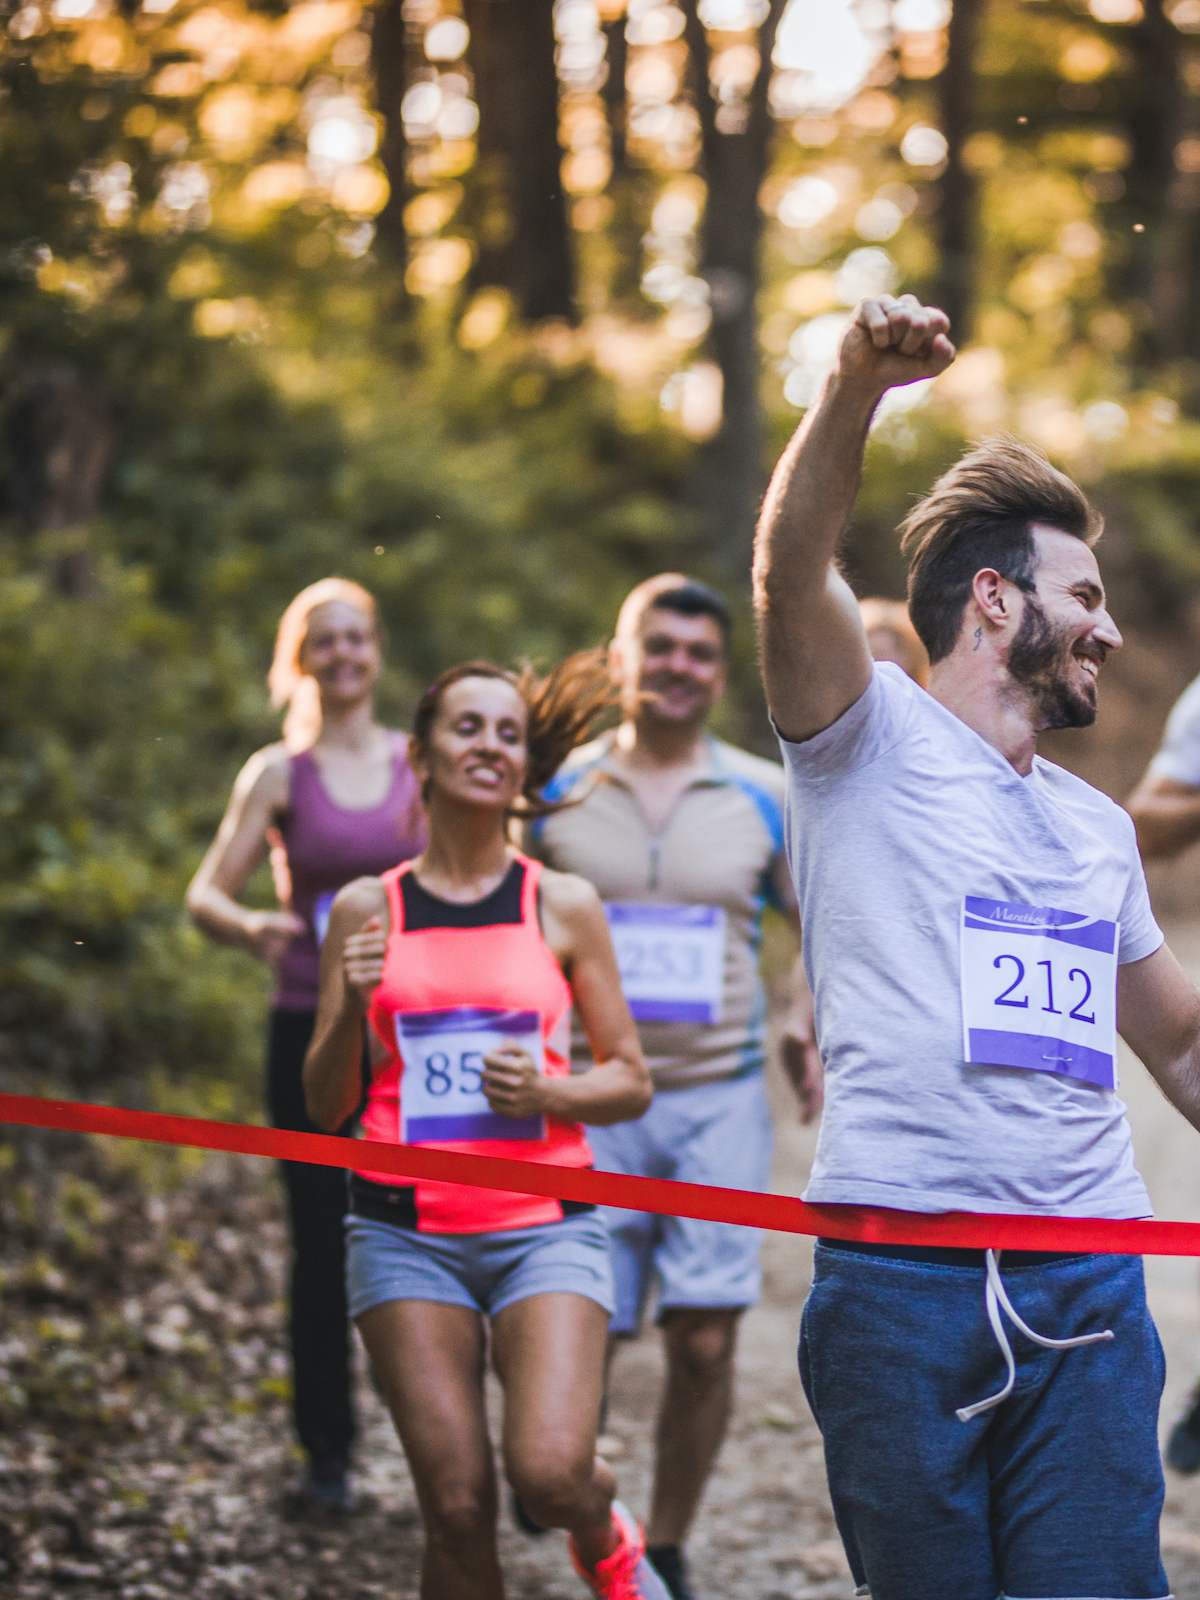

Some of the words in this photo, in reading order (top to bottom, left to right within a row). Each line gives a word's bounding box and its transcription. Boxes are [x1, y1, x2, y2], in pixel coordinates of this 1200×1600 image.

[989, 906, 1046, 925] Marathon
[618, 939, 704, 982] 253
[993, 954, 1095, 1025] 212
